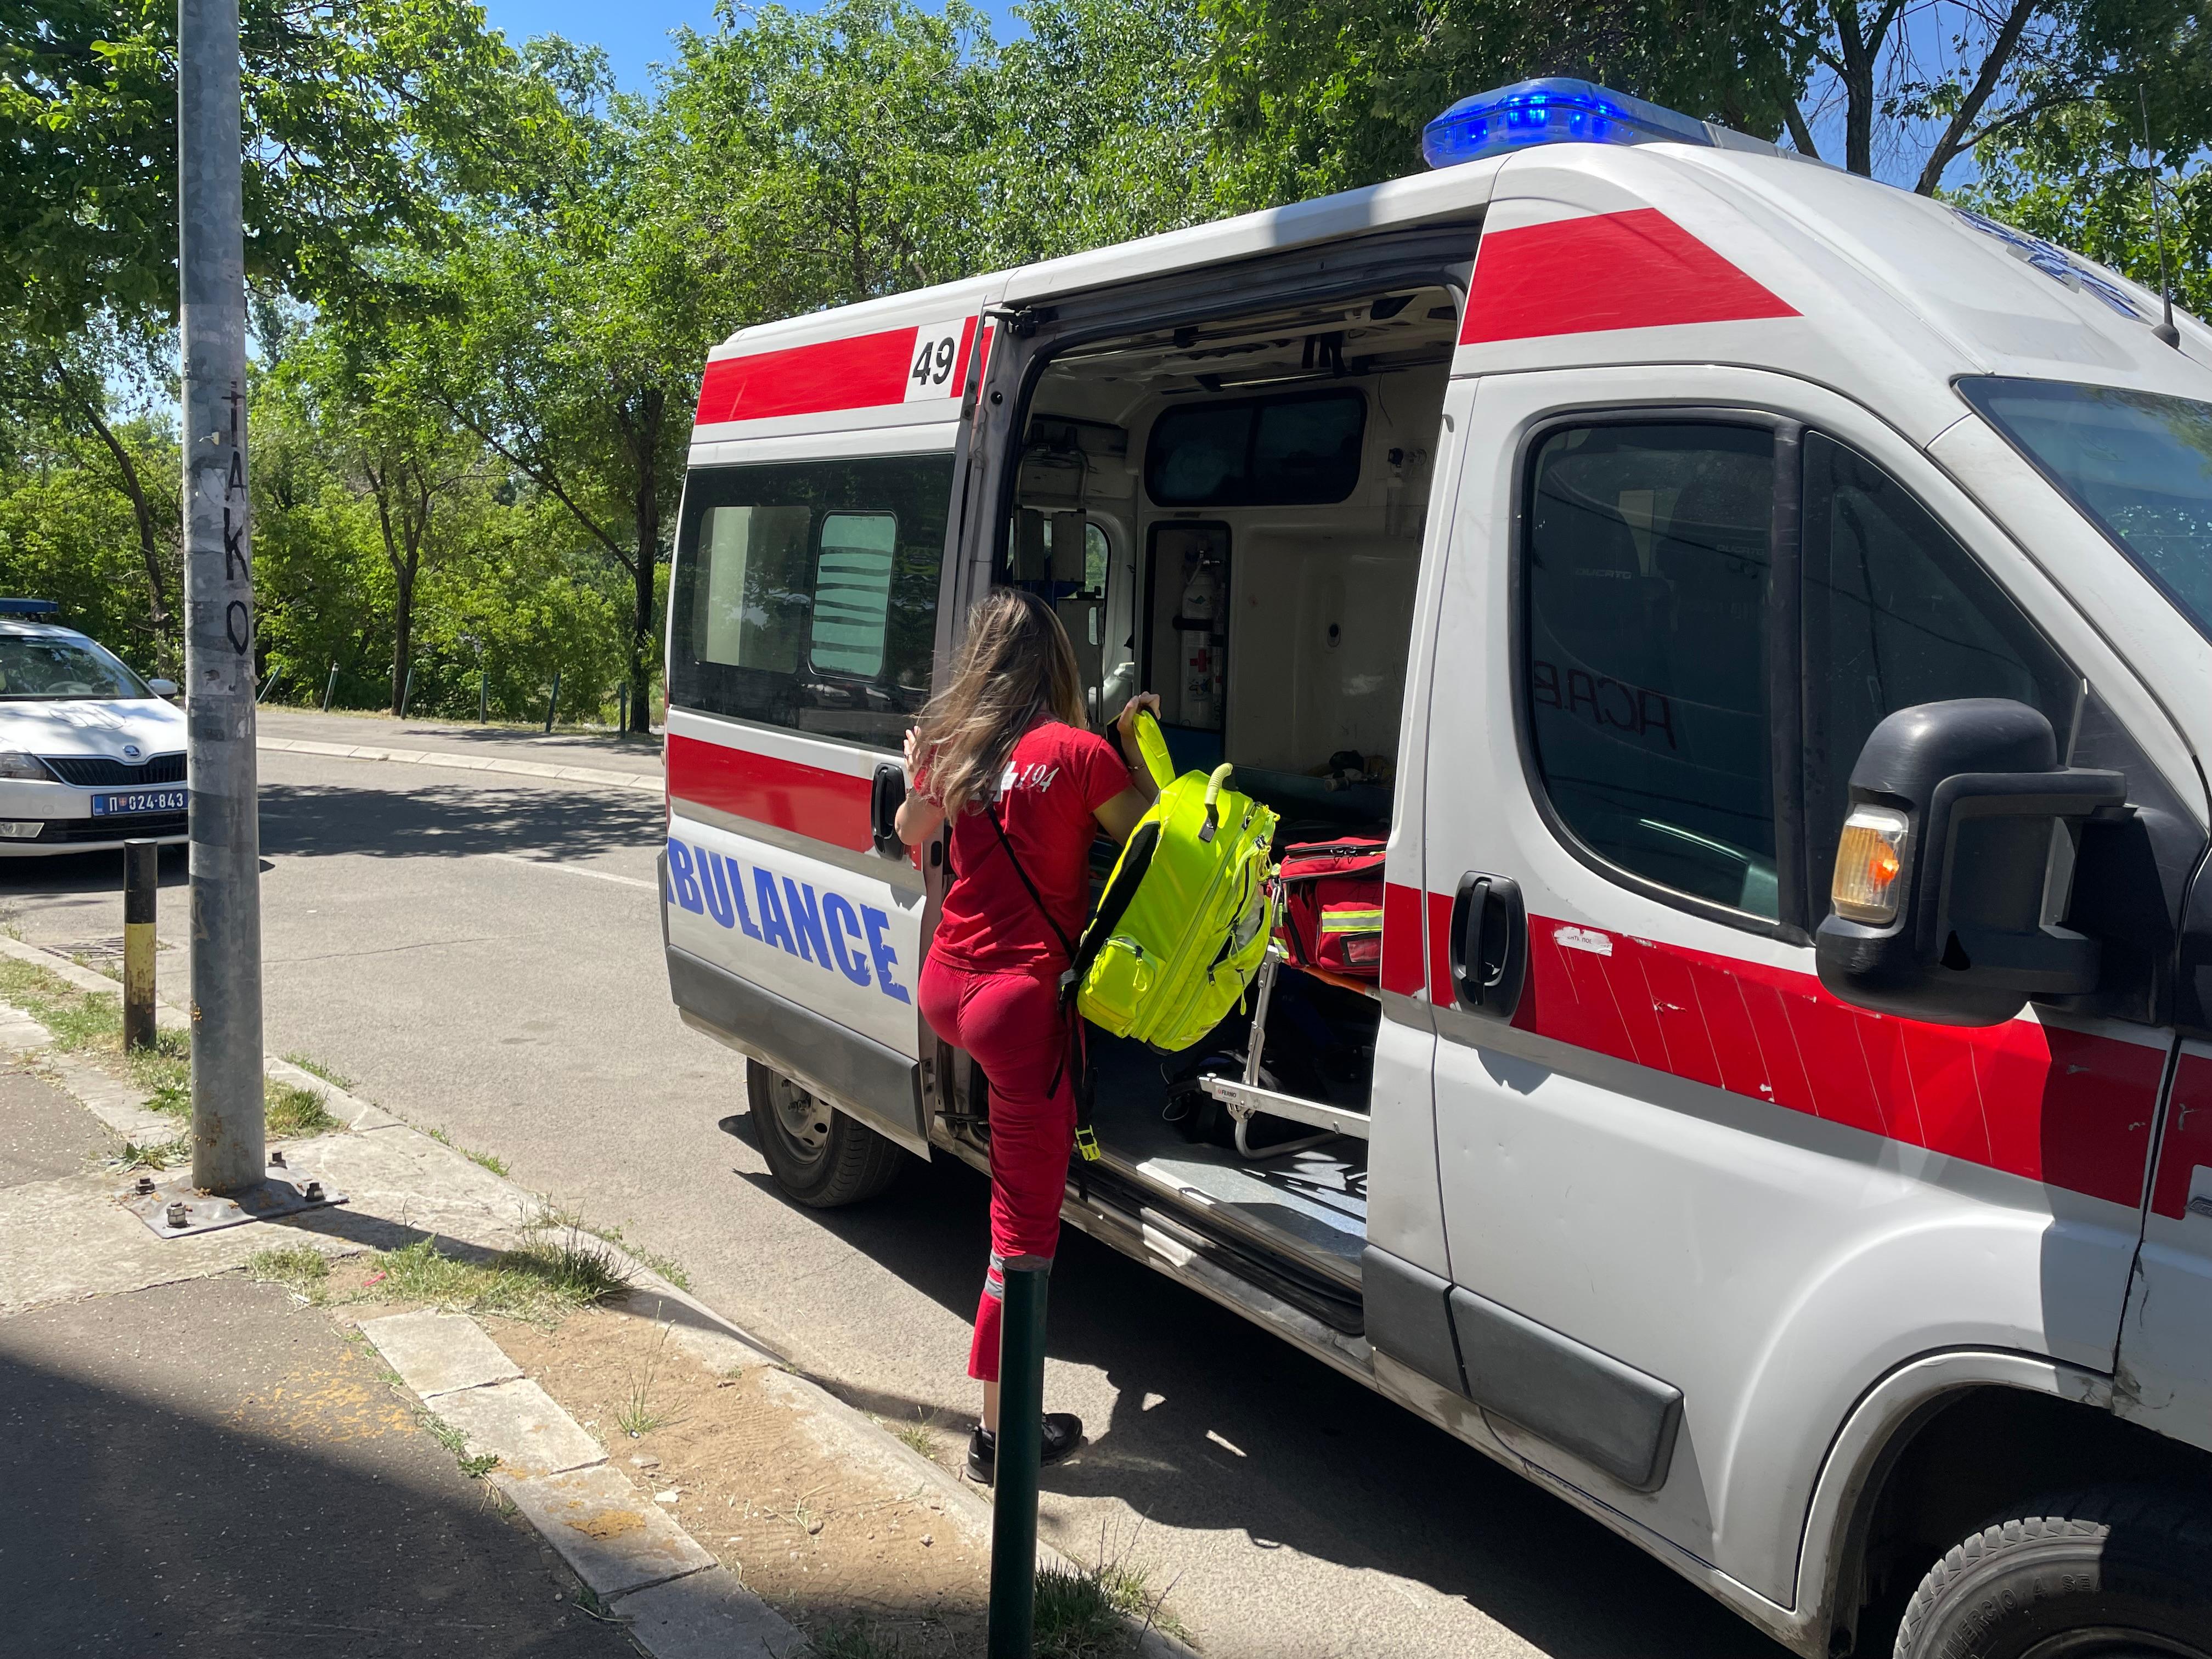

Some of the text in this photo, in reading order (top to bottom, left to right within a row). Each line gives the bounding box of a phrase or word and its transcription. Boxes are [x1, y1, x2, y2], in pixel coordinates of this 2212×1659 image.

[912, 337, 955, 385] 49
[1575, 568, 1633, 579] DUCATO
[1015, 763, 1059, 793] 194
[668, 837, 911, 1006] BULANCE
[1222, 1090, 1237, 1098] FERNO
